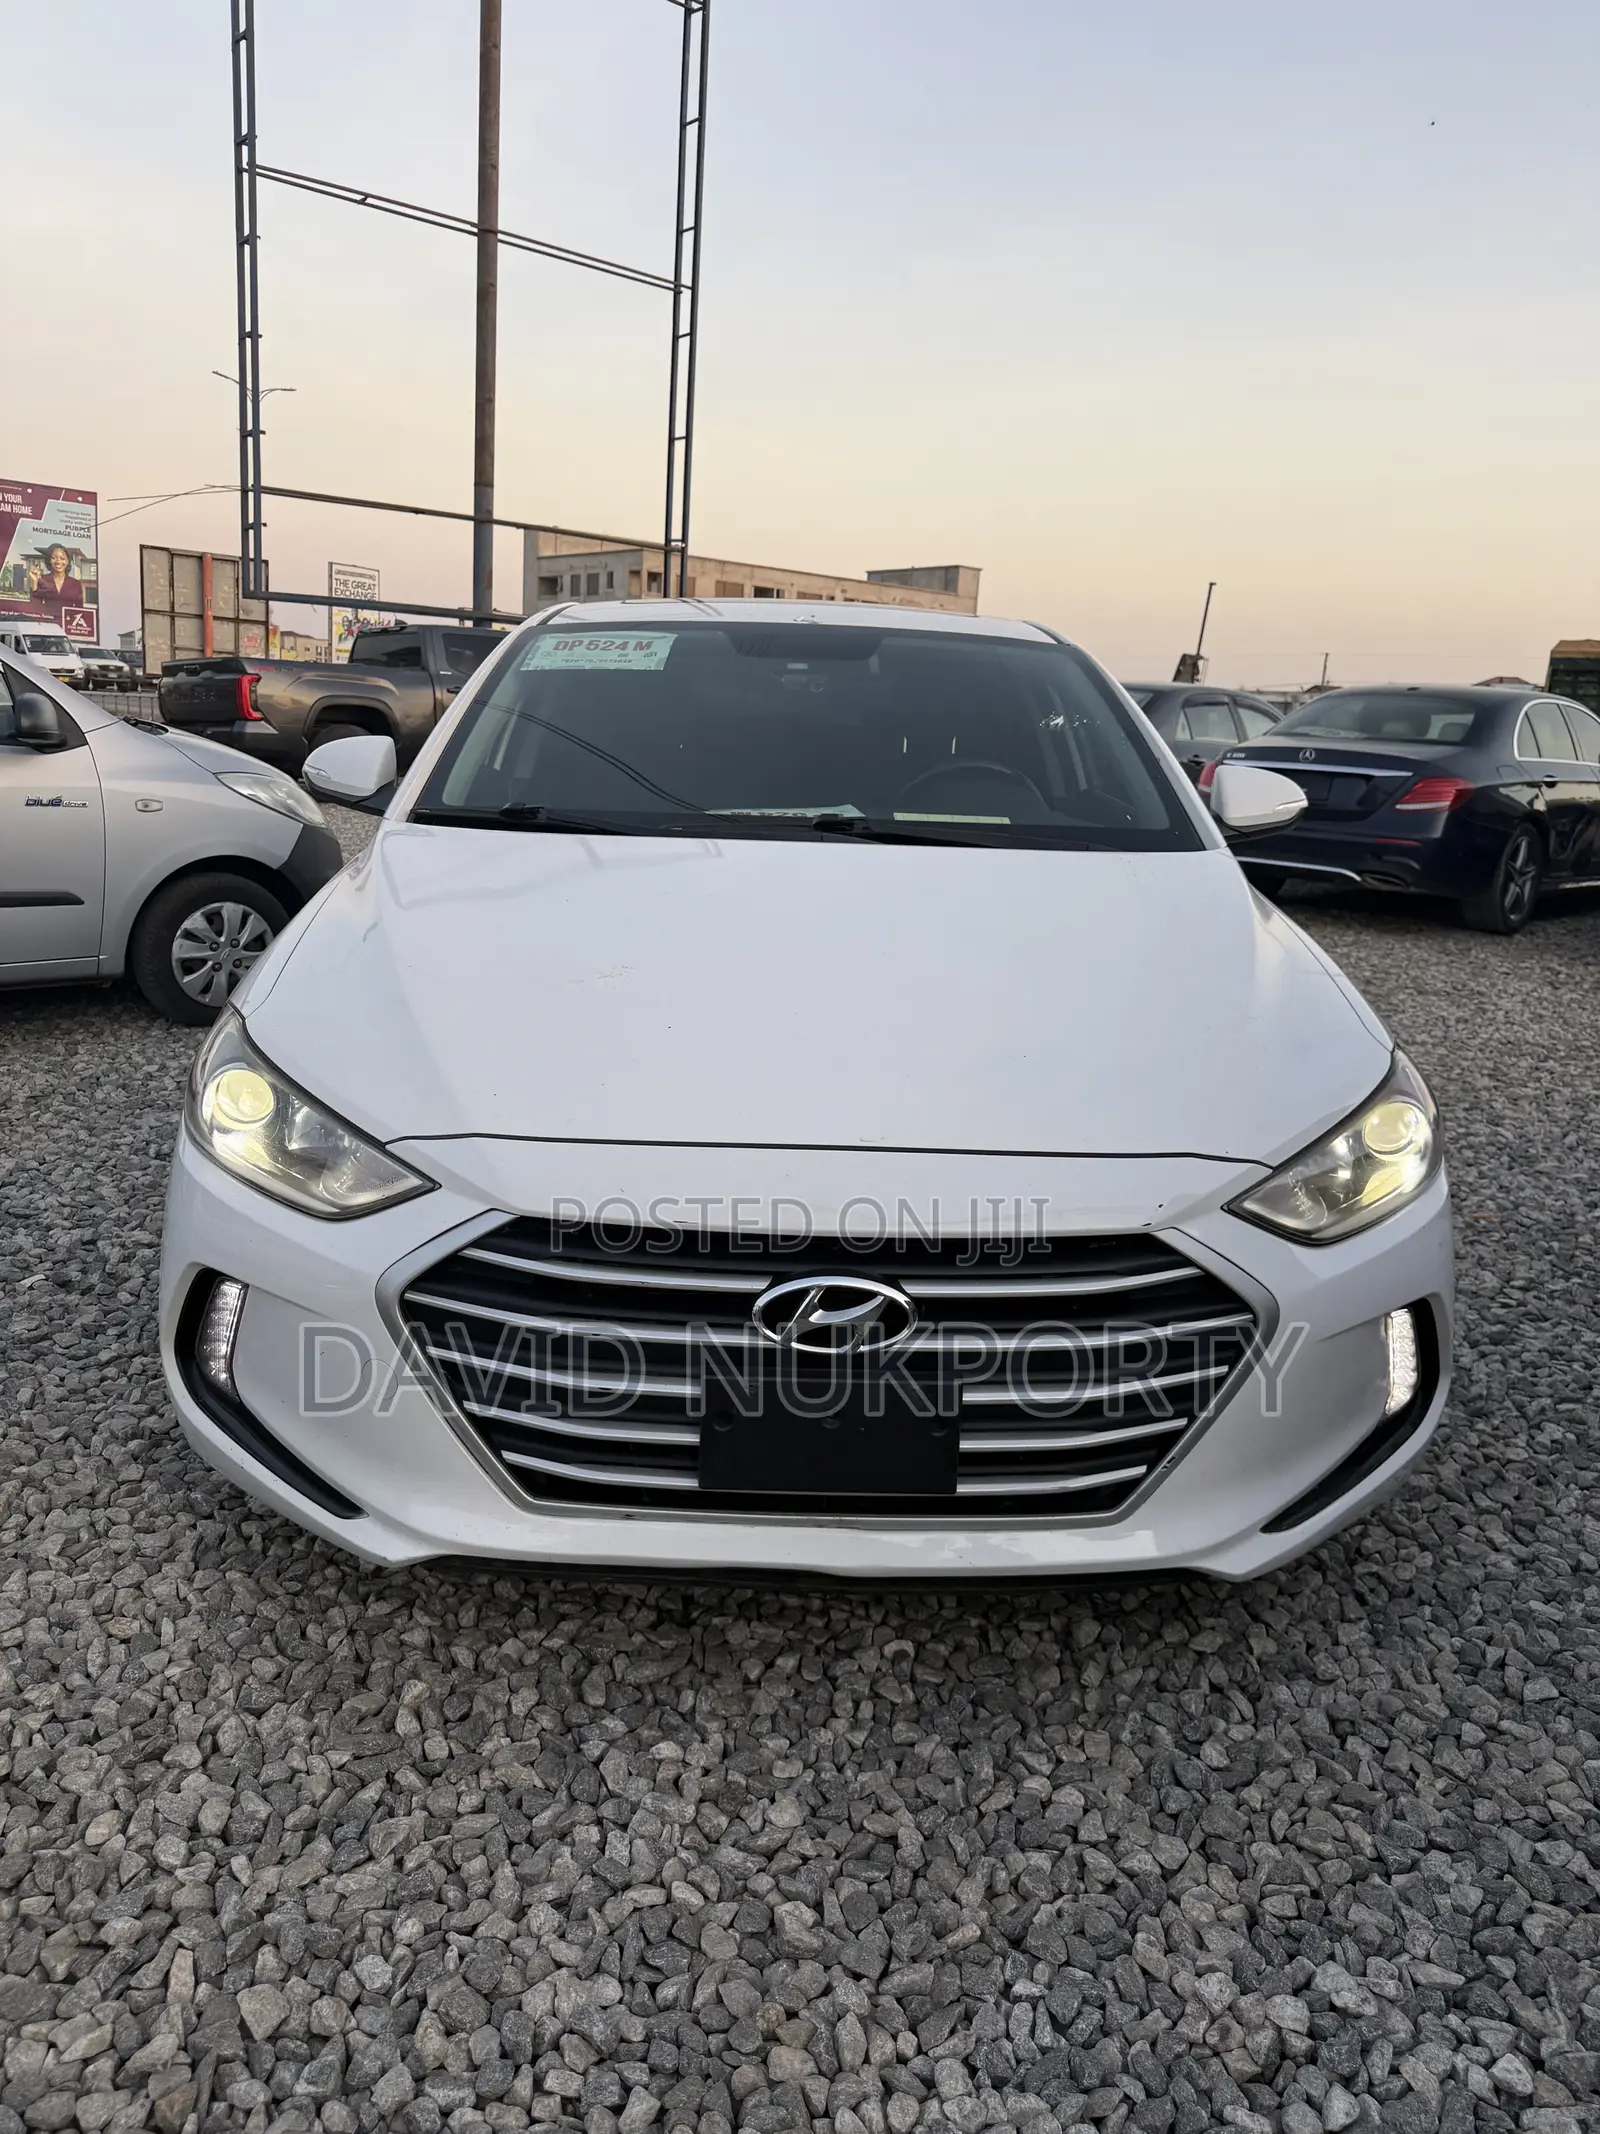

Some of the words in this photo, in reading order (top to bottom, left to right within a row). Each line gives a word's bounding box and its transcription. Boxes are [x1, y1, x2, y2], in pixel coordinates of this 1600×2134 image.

[3, 492, 22, 504] YOUR
[12, 504, 33, 515] HOME
[32, 526, 72, 537] MORTGAGE
[72, 531, 92, 540] LOAN
[64, 524, 92, 534] PURPLE
[334, 578, 350, 589] THE
[351, 580, 376, 592] GREAT
[334, 587, 377, 600] EXCHANGE
[553, 639, 584, 651] DP
[585, 639, 630, 651] 524
[632, 640, 654, 651] M
